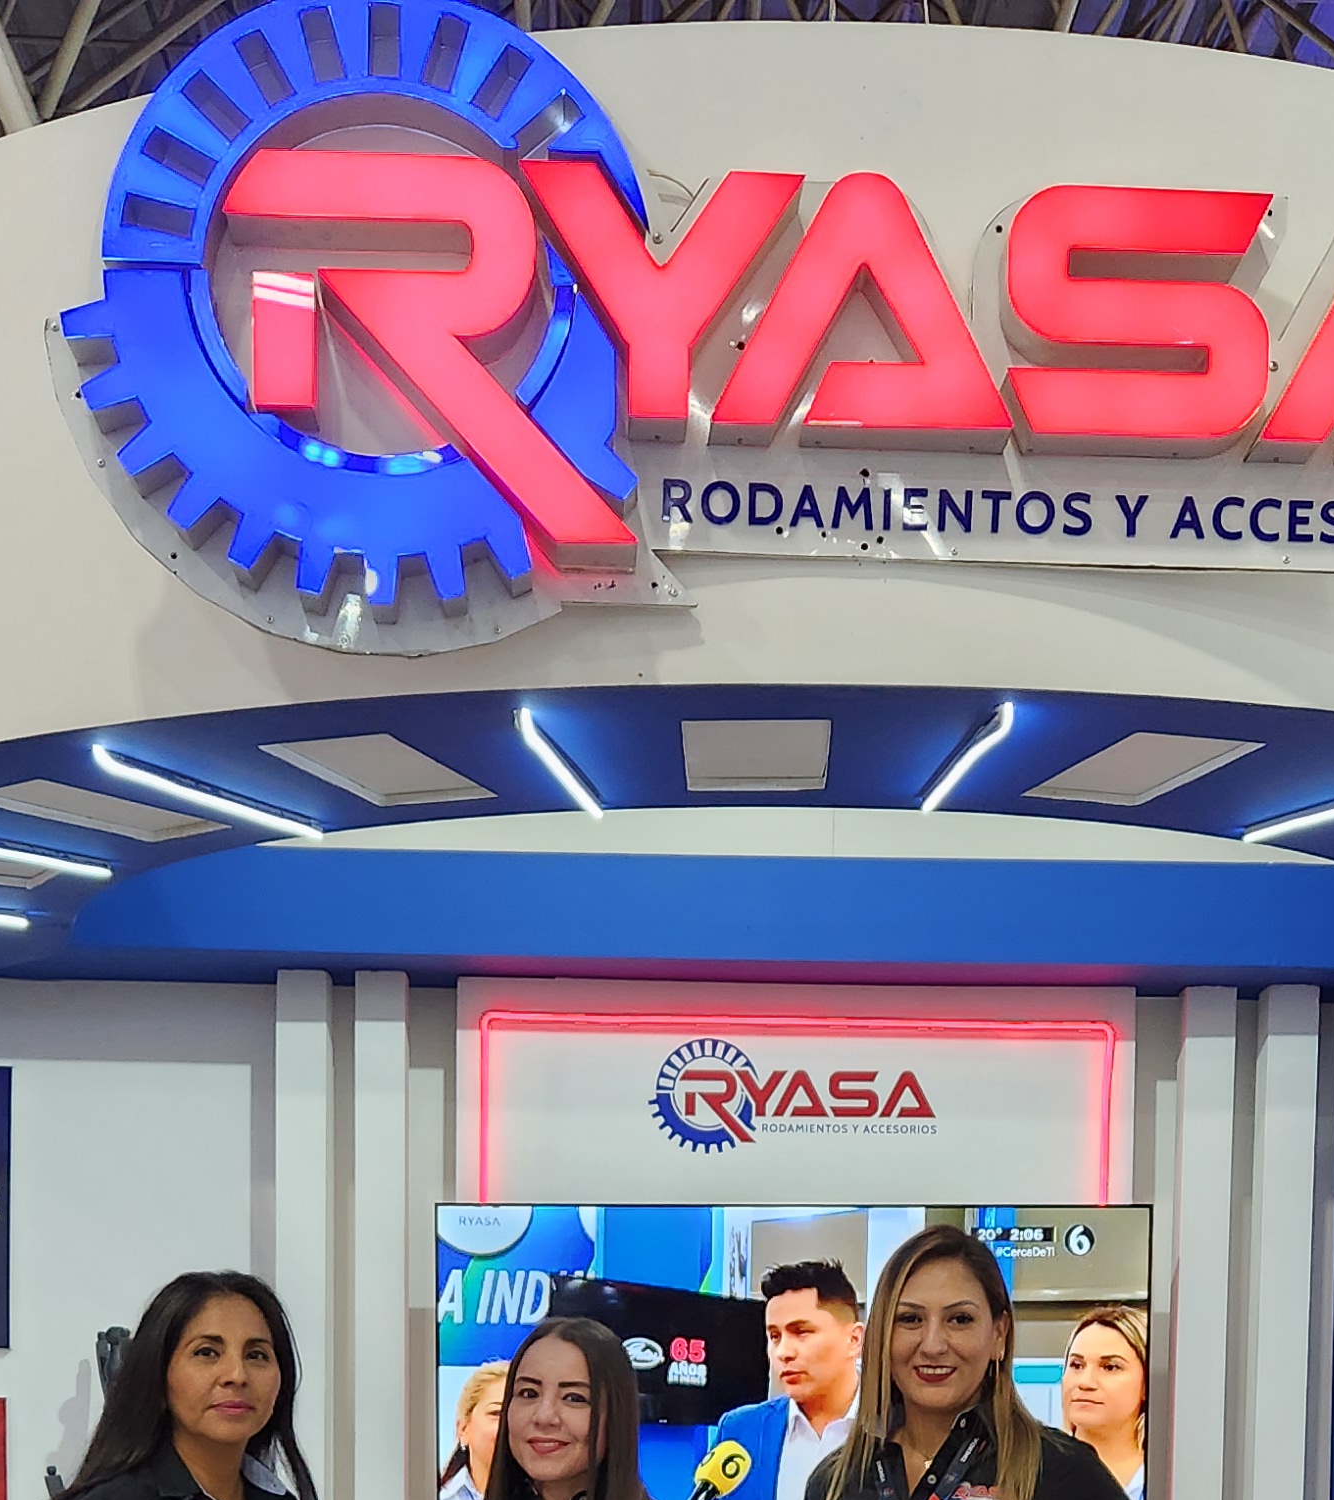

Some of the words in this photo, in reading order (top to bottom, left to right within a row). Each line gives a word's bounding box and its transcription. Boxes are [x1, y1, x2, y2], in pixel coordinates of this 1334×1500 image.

[662, 478, 1092, 538] RODAMIENTOS
[1114, 494, 1149, 538] Y
[680, 1069, 936, 1143] RYASA
[762, 1123, 849, 1134] RODAMIENTOS
[852, 1124, 860, 1134] Y
[863, 1124, 938, 1135] ACCESORIOS
[458, 1216, 501, 1227] RYASA
[978, 1227, 1003, 1241] 20°
[1010, 1227, 1044, 1242] 2:06
[1069, 1225, 1091, 1256] 6
[476, 1269, 555, 1326] IND
[670, 1337, 706, 1363] 65
[721, 1454, 747, 1478] 6
